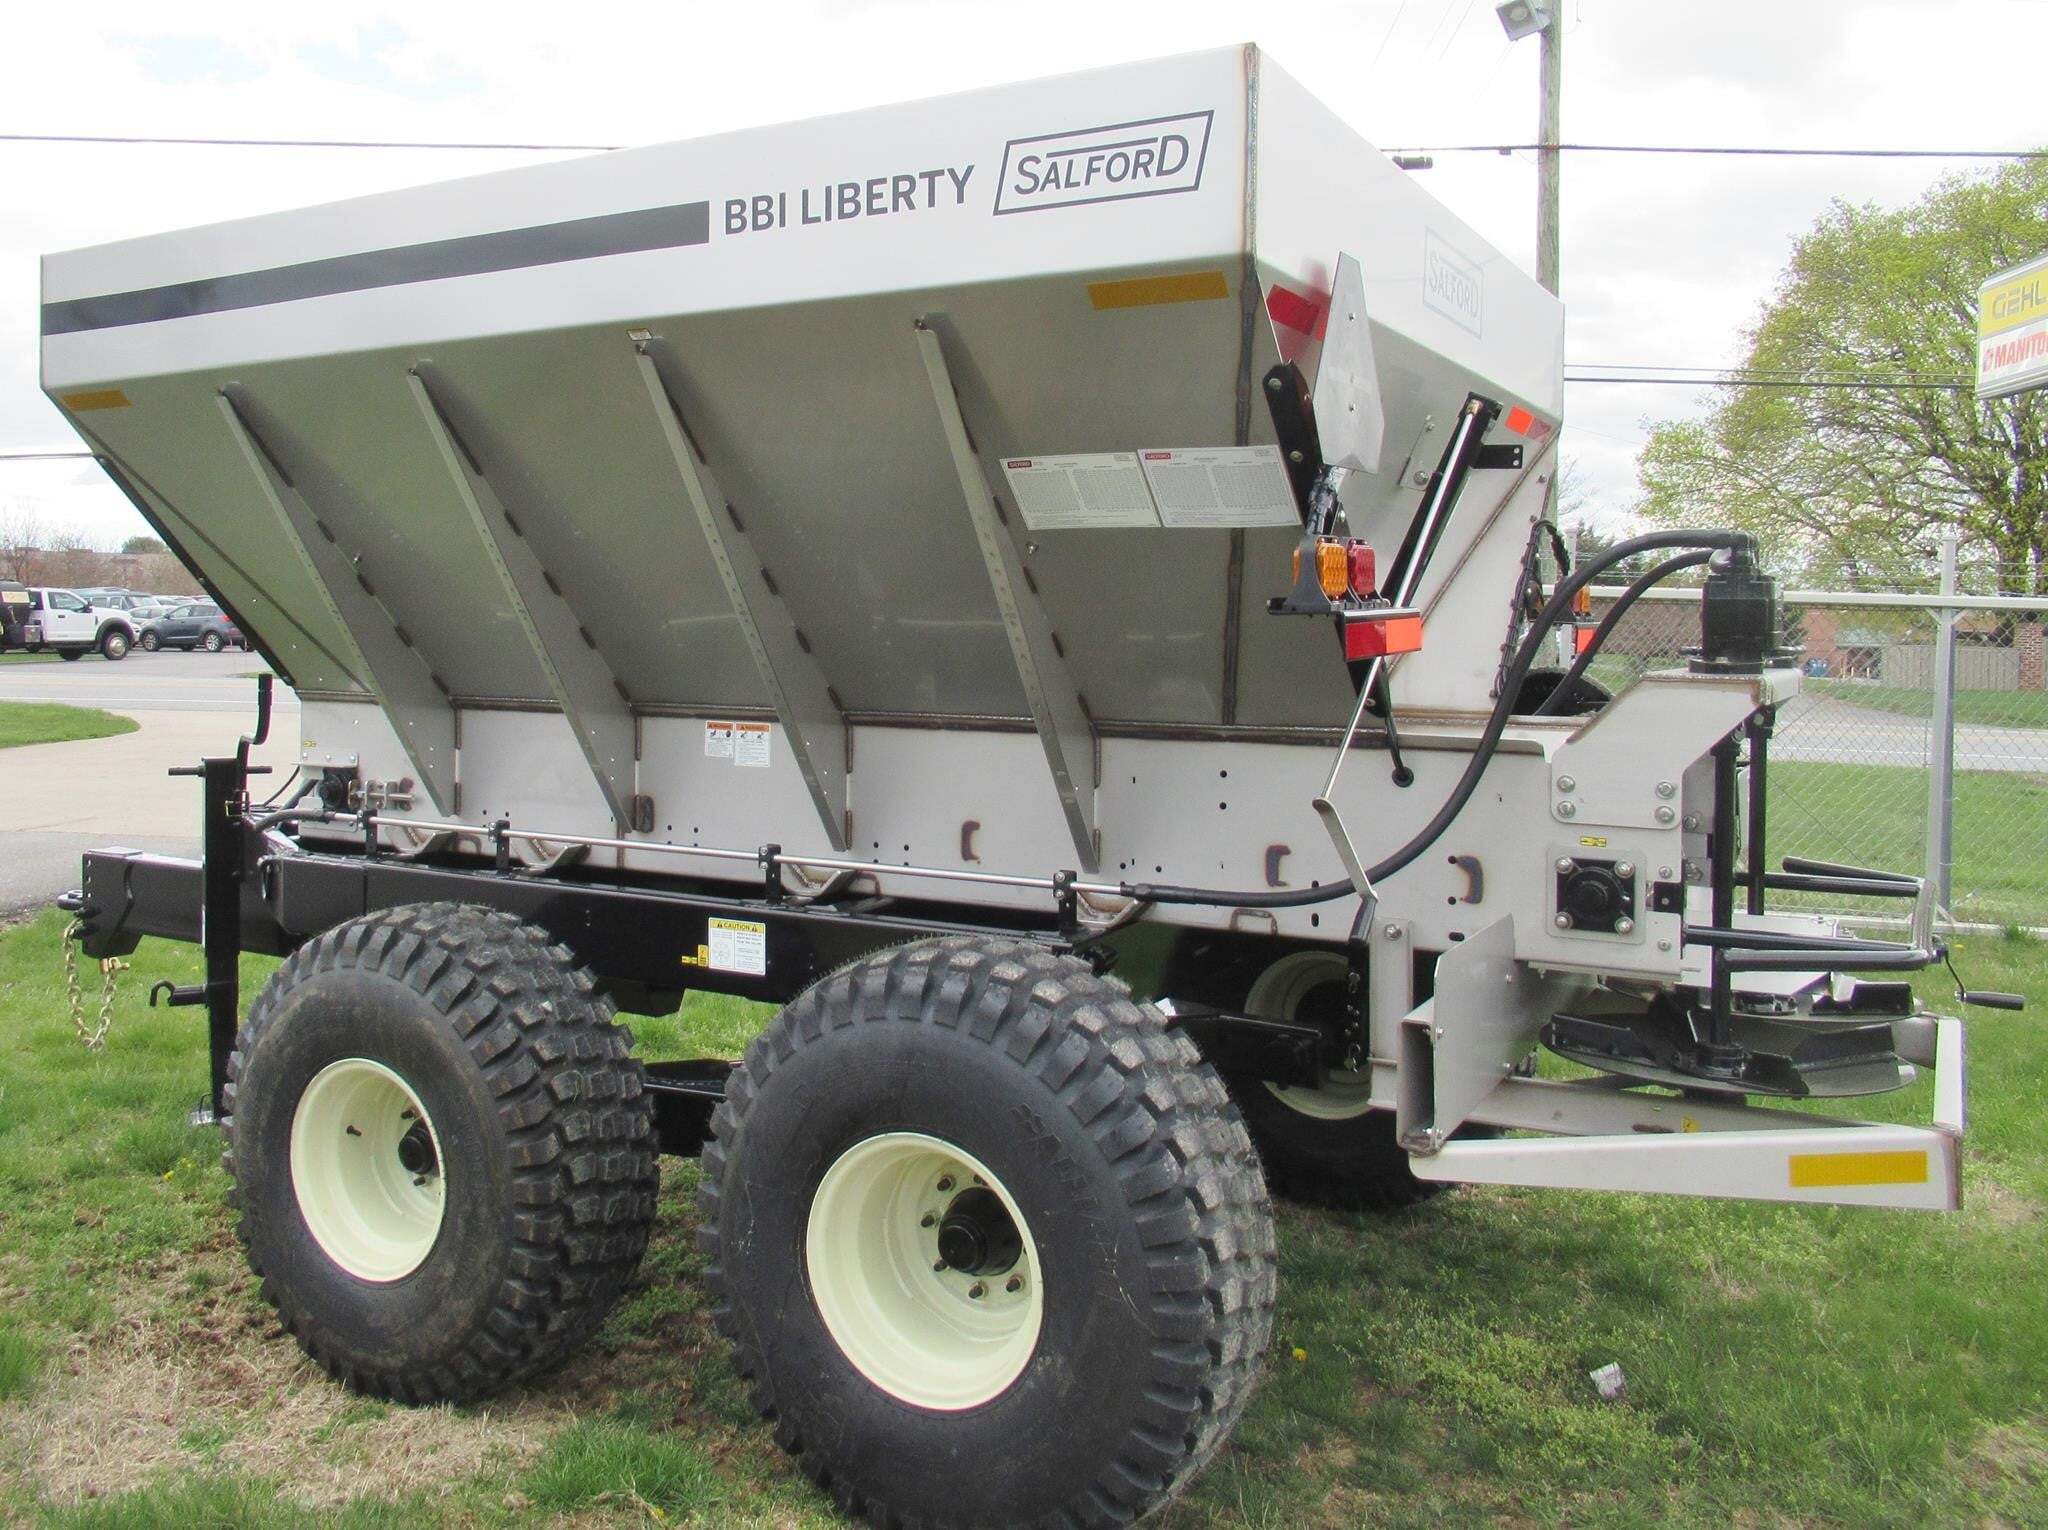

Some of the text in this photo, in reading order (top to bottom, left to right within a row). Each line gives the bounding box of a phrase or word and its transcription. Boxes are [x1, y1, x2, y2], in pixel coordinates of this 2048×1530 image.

[1014, 132, 1190, 196] SALFORD
[725, 165, 975, 235] BBI LIBERTY
[1428, 249, 1479, 318] SALFORD
[1992, 279, 2047, 319] GEHL
[1994, 331, 2048, 369] MANITO
[724, 921, 750, 931] CAUTION
